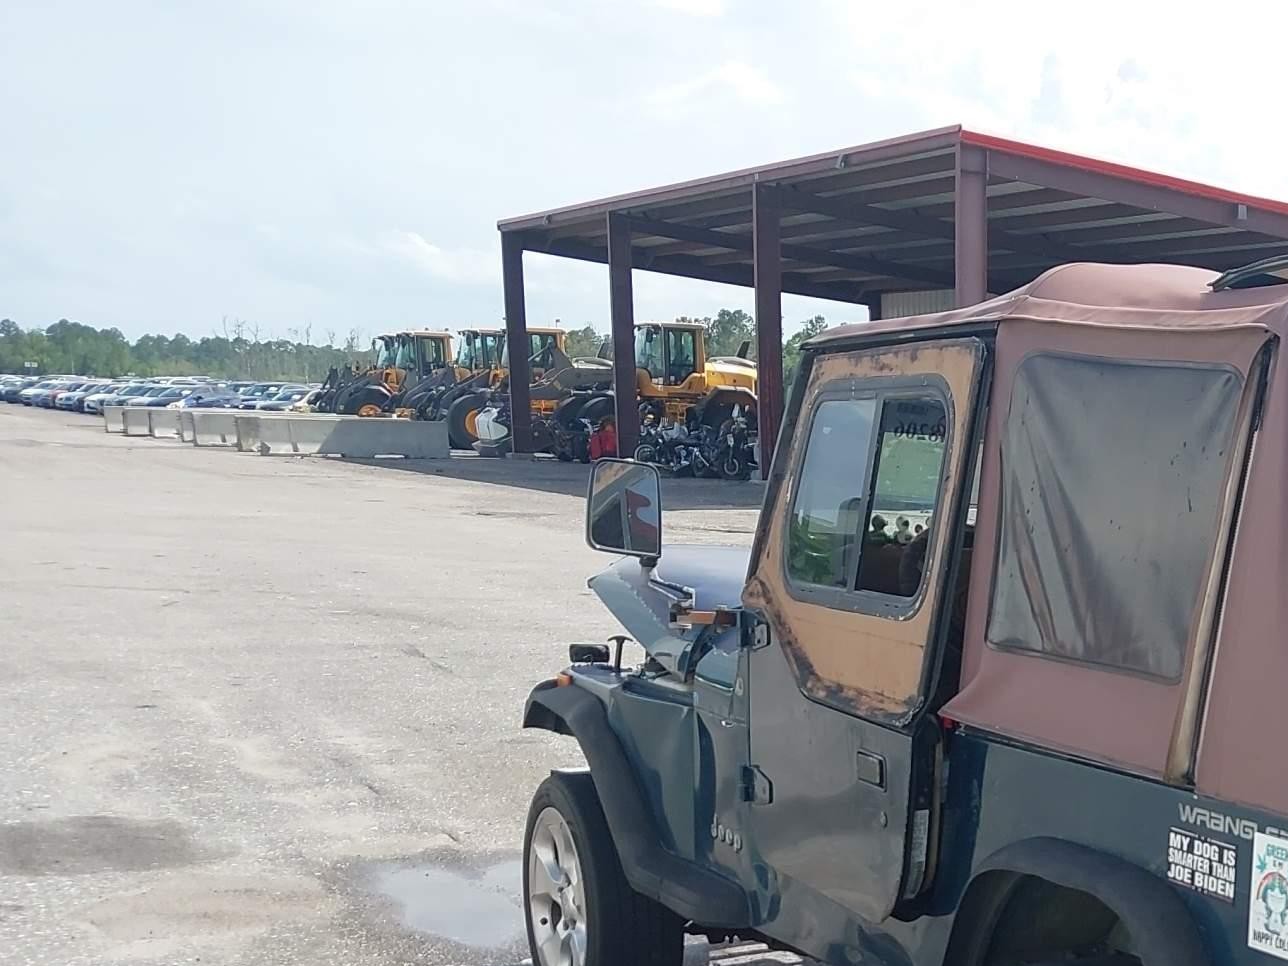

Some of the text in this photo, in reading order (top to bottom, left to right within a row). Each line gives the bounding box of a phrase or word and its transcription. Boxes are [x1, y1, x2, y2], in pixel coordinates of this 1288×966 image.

[711, 813, 741, 851] Jeep
[1169, 832, 1236, 866] MY DOG IS
[1167, 863, 1235, 899] JOE BIDEN
[1168, 847, 1236, 883] SMARTER THAN
[1253, 928, 1273, 946] HAPPY
